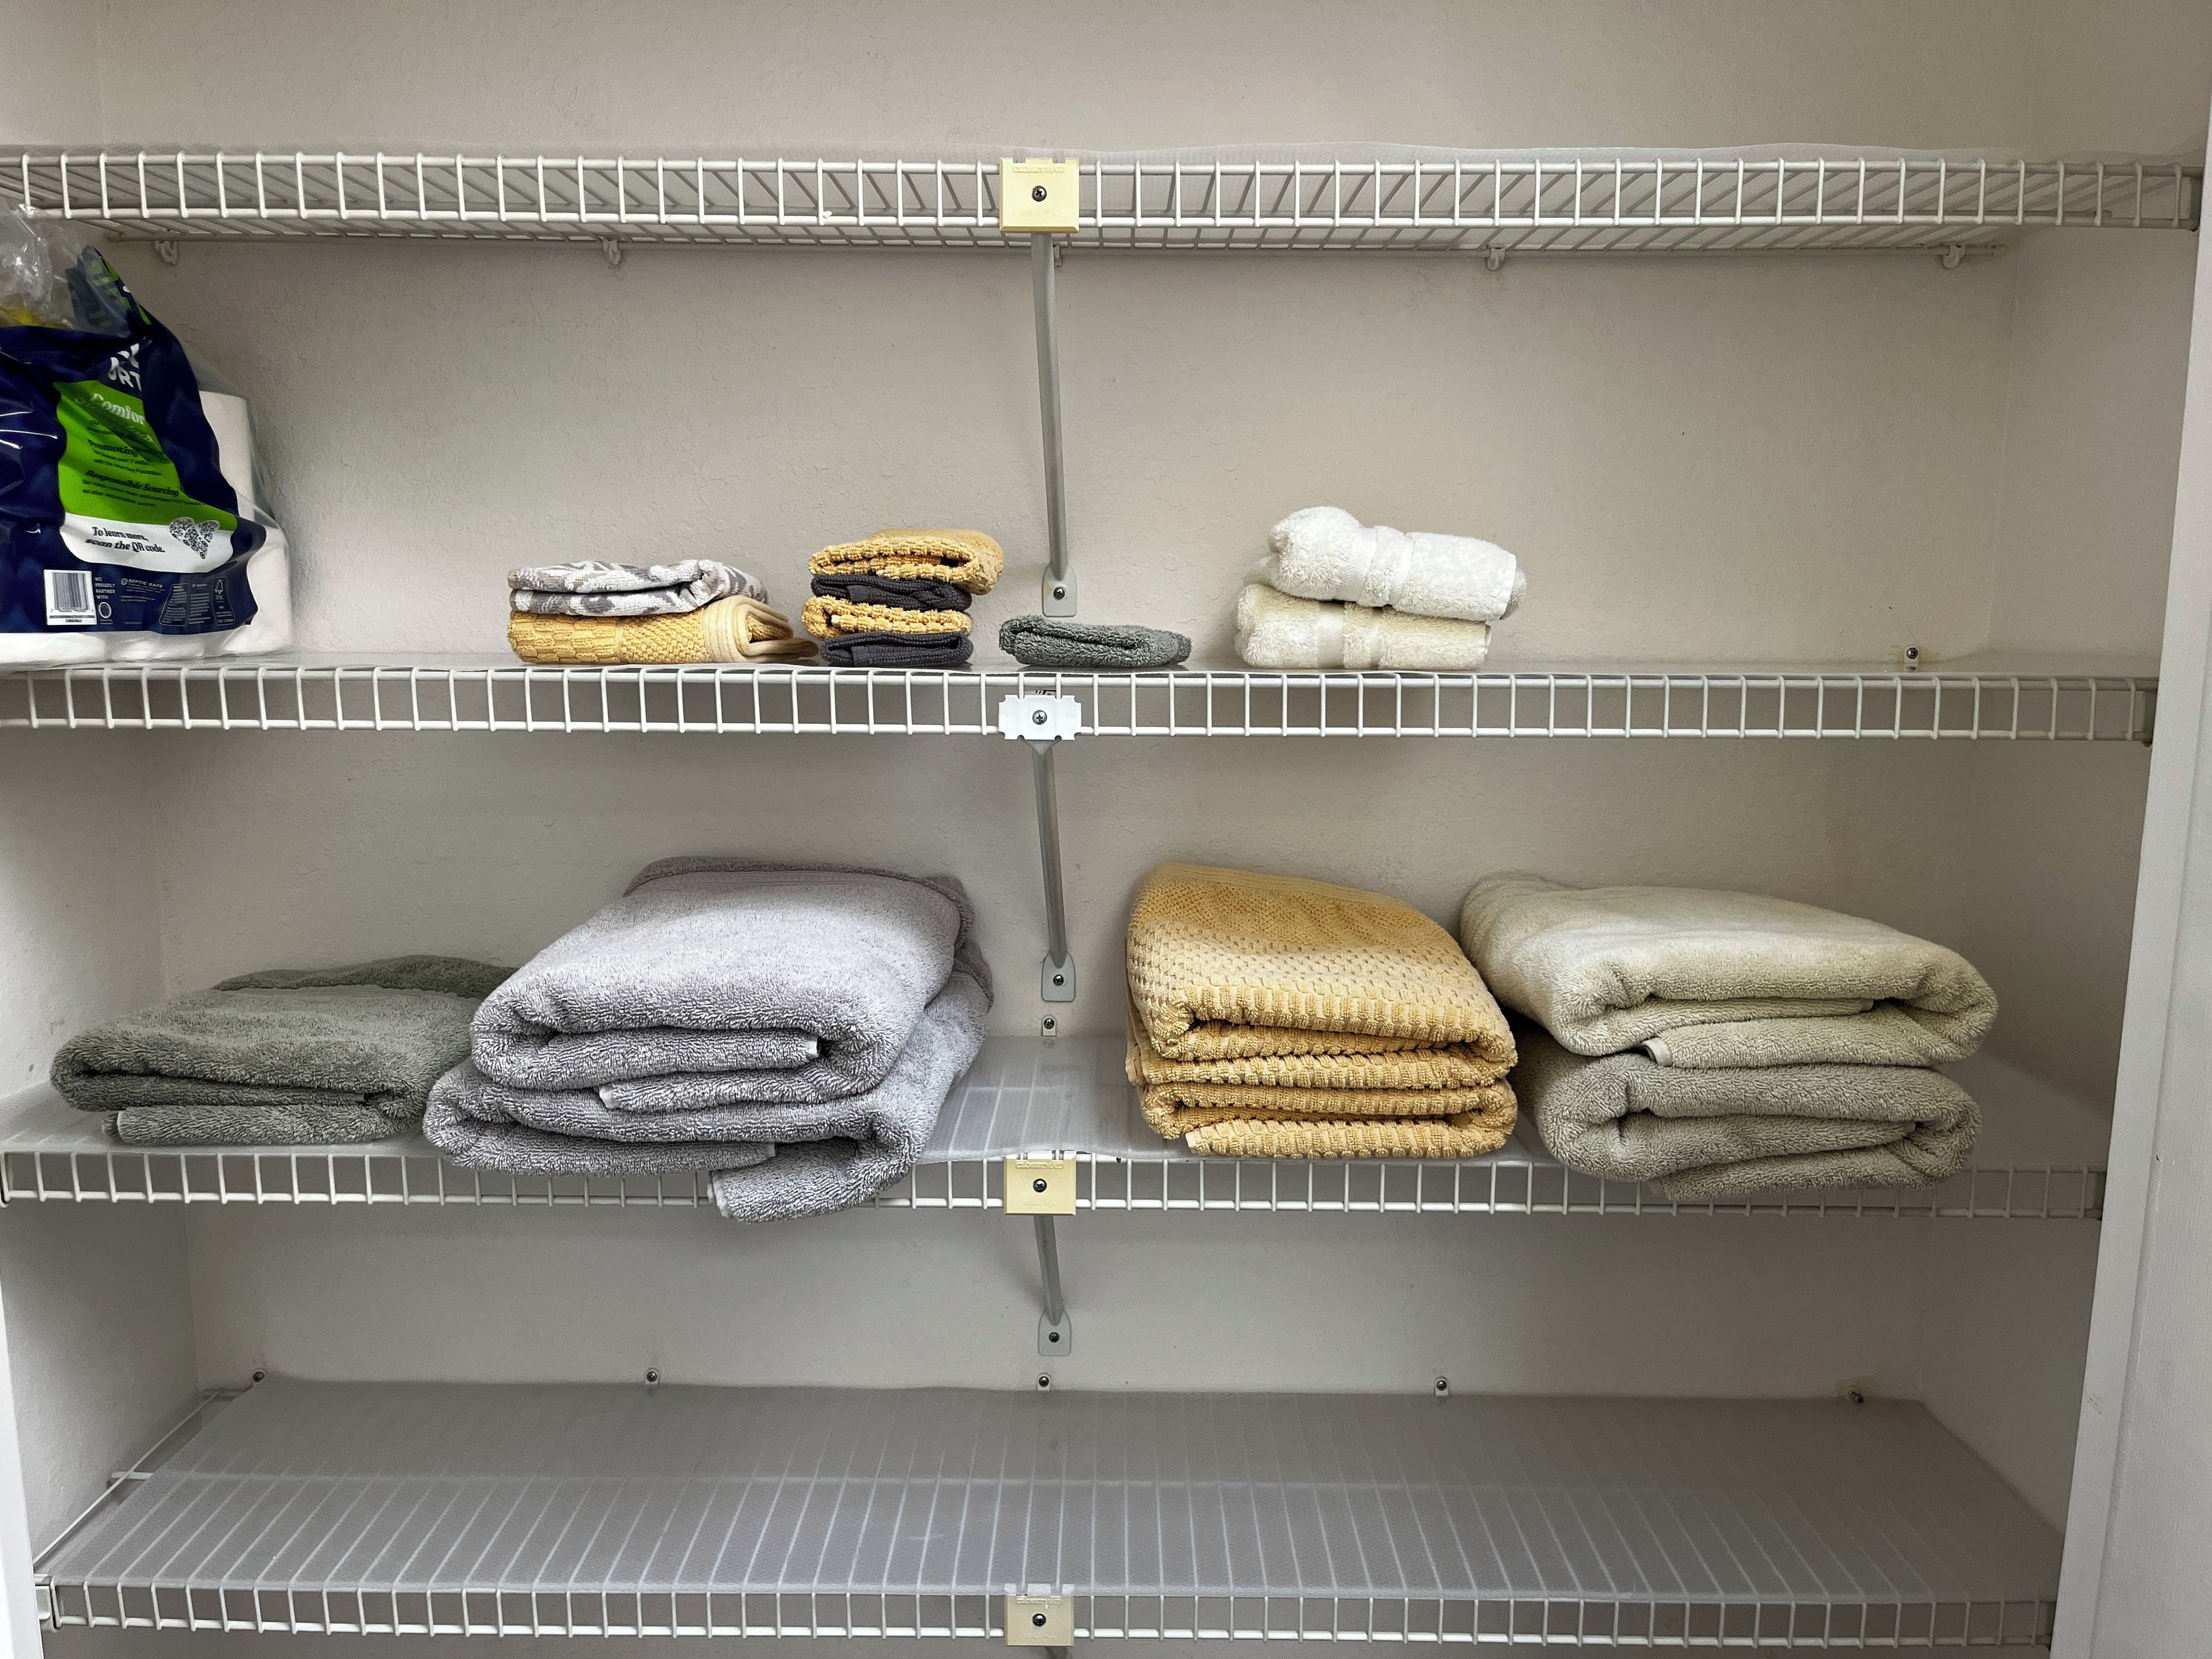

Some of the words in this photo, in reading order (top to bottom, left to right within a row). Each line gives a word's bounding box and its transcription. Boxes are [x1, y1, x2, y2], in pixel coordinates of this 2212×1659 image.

[85, 470, 142, 489] Responsible
[143, 484, 179, 497] Sourcing
[92, 527, 104, 536] To
[103, 528, 126, 539] learn
[126, 533, 149, 542] more,
[85, 539, 112, 548] scan
[115, 541, 130, 550] the
[132, 542, 145, 552] QR
[145, 544, 165, 553] code.
